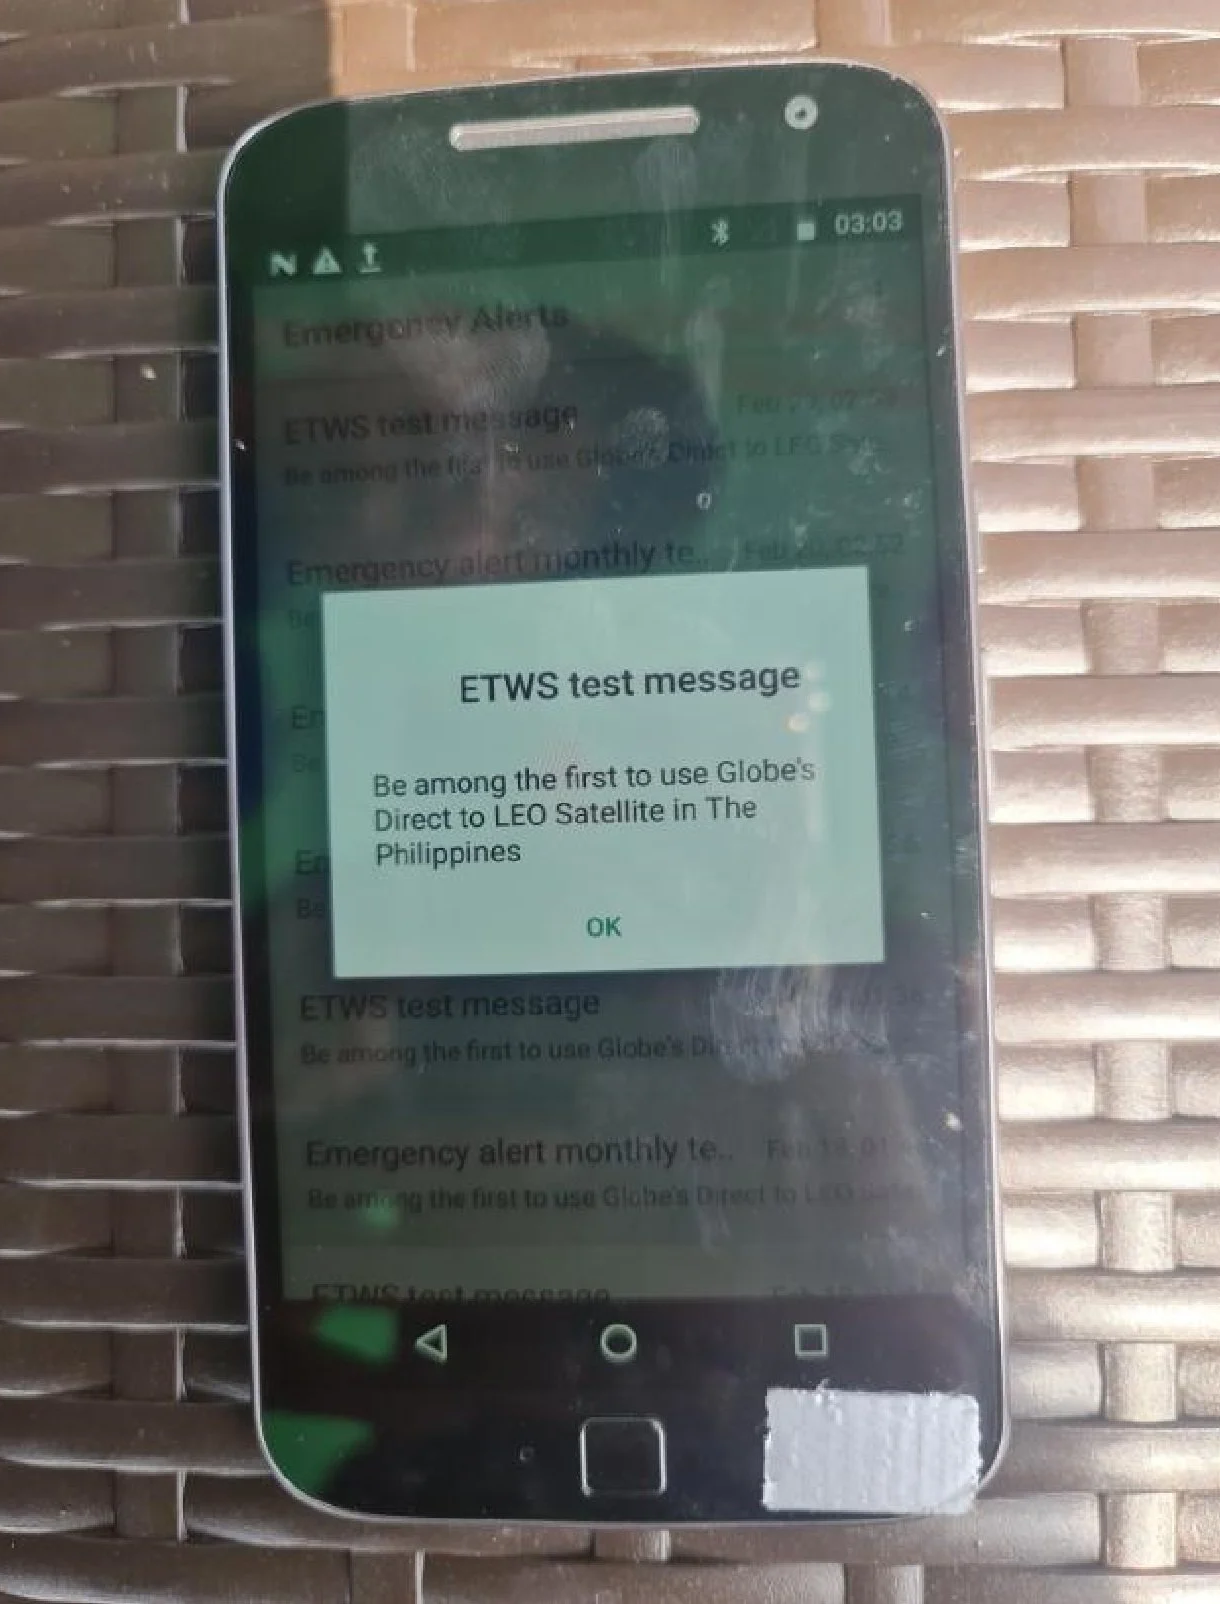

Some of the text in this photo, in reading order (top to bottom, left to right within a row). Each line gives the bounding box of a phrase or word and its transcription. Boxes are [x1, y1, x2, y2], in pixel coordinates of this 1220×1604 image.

[834, 209, 903, 235] 03:03
[460, 666, 800, 704] ETWS test message
[374, 756, 815, 801] Be among the first to use Globe's
[374, 795, 757, 833] Direct to LEO Satellite in The
[376, 840, 522, 871] Philippines
[585, 916, 623, 939] OK
[300, 993, 600, 1022] ETWS test message
[306, 1139, 470, 1172] Emergency
[479, 1138, 544, 1166] alert
[555, 1132, 679, 1168] monthly
